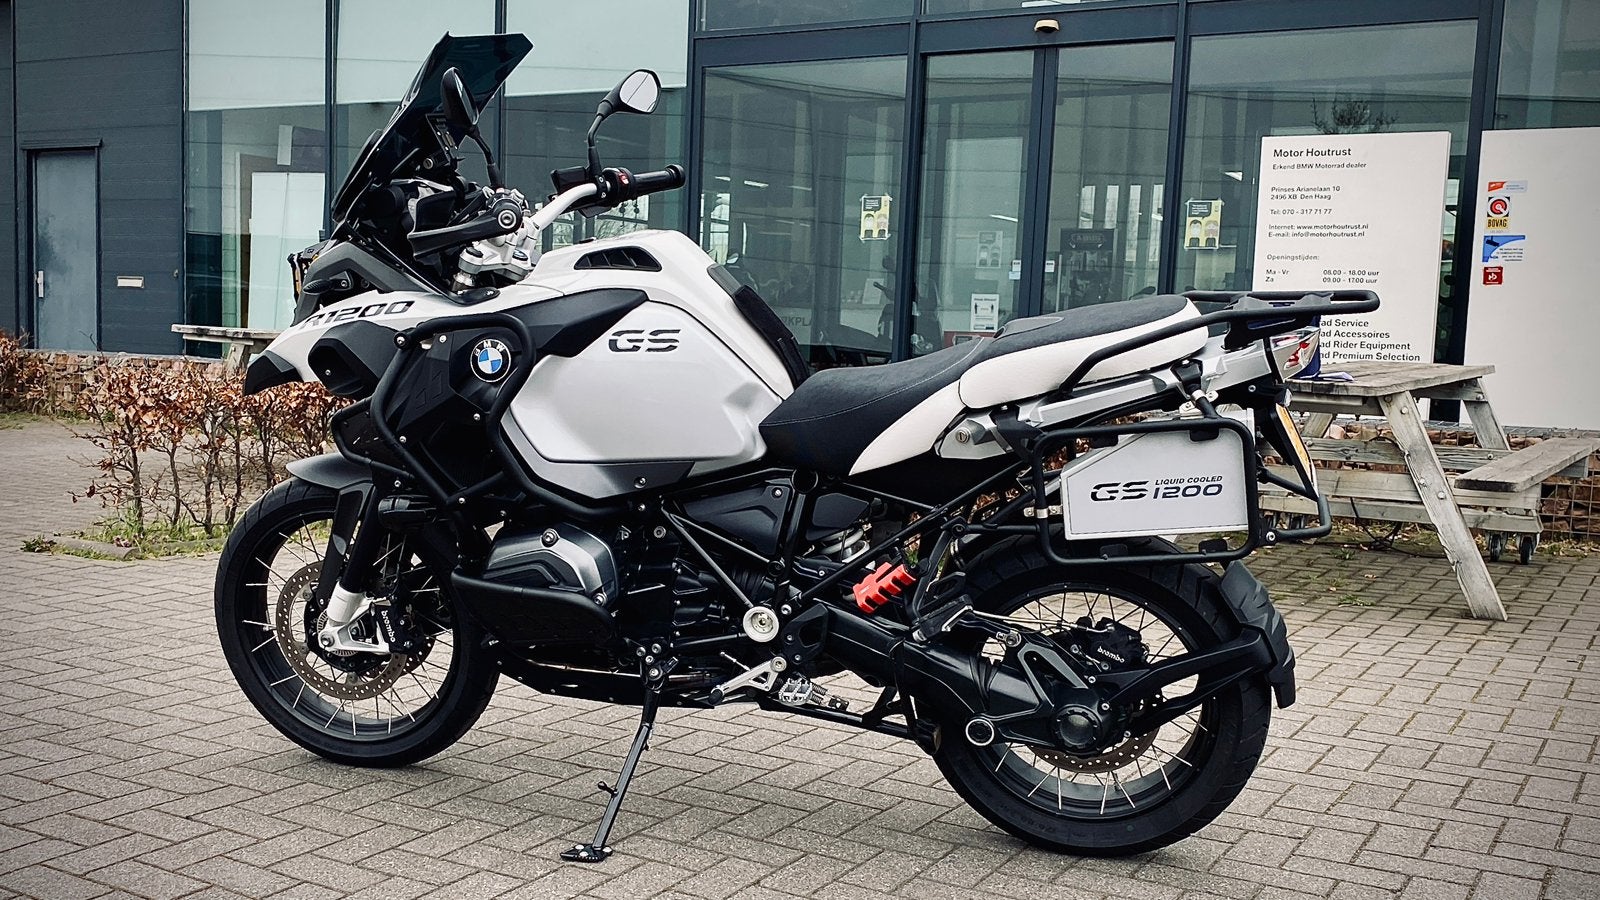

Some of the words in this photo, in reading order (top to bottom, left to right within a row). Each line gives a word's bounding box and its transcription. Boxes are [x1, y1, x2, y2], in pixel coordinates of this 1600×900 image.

[1273, 149, 1304, 157] Motor
[1306, 148, 1352, 157] Houtrust
[1488, 219, 1508, 228] BOVAG
[1334, 319, 1369, 327] Service
[1333, 330, 1390, 338] Accessoires
[608, 329, 682, 353] GS
[1333, 341, 1358, 349] Rider
[1360, 341, 1411, 350] Equipment
[1333, 352, 1373, 360] Premium
[1376, 352, 1421, 361] Selection
[1155, 478, 1185, 486] LIQUID
[1187, 476, 1223, 484] COOLED
[1090, 481, 1149, 501] GS
[1153, 484, 1223, 499] 1200
[381, 610, 396, 643] brembo
[1097, 646, 1125, 663] brembo
